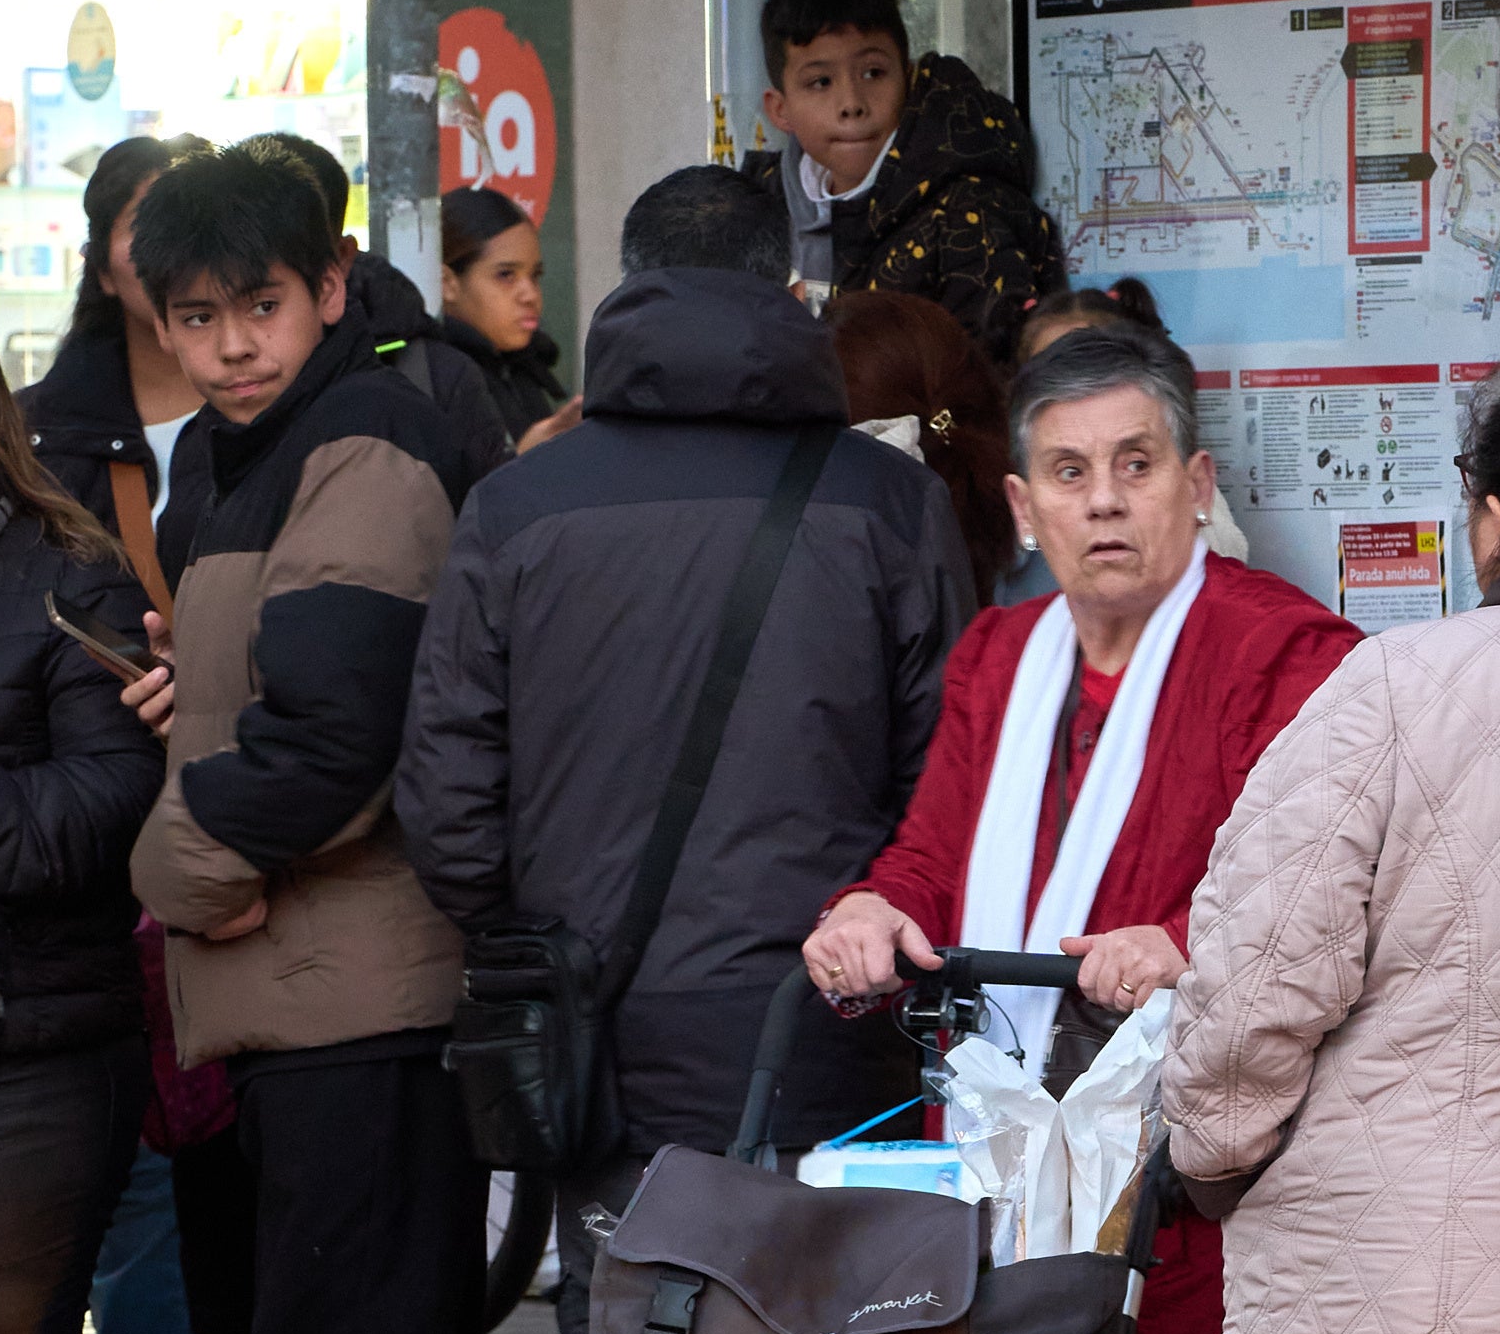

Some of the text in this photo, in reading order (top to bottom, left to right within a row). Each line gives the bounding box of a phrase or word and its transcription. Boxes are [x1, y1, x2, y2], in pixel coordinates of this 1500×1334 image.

[1444, 2, 1453, 17] 2
[1420, 536, 1436, 549] LH2
[1349, 567, 1384, 582] Parada
